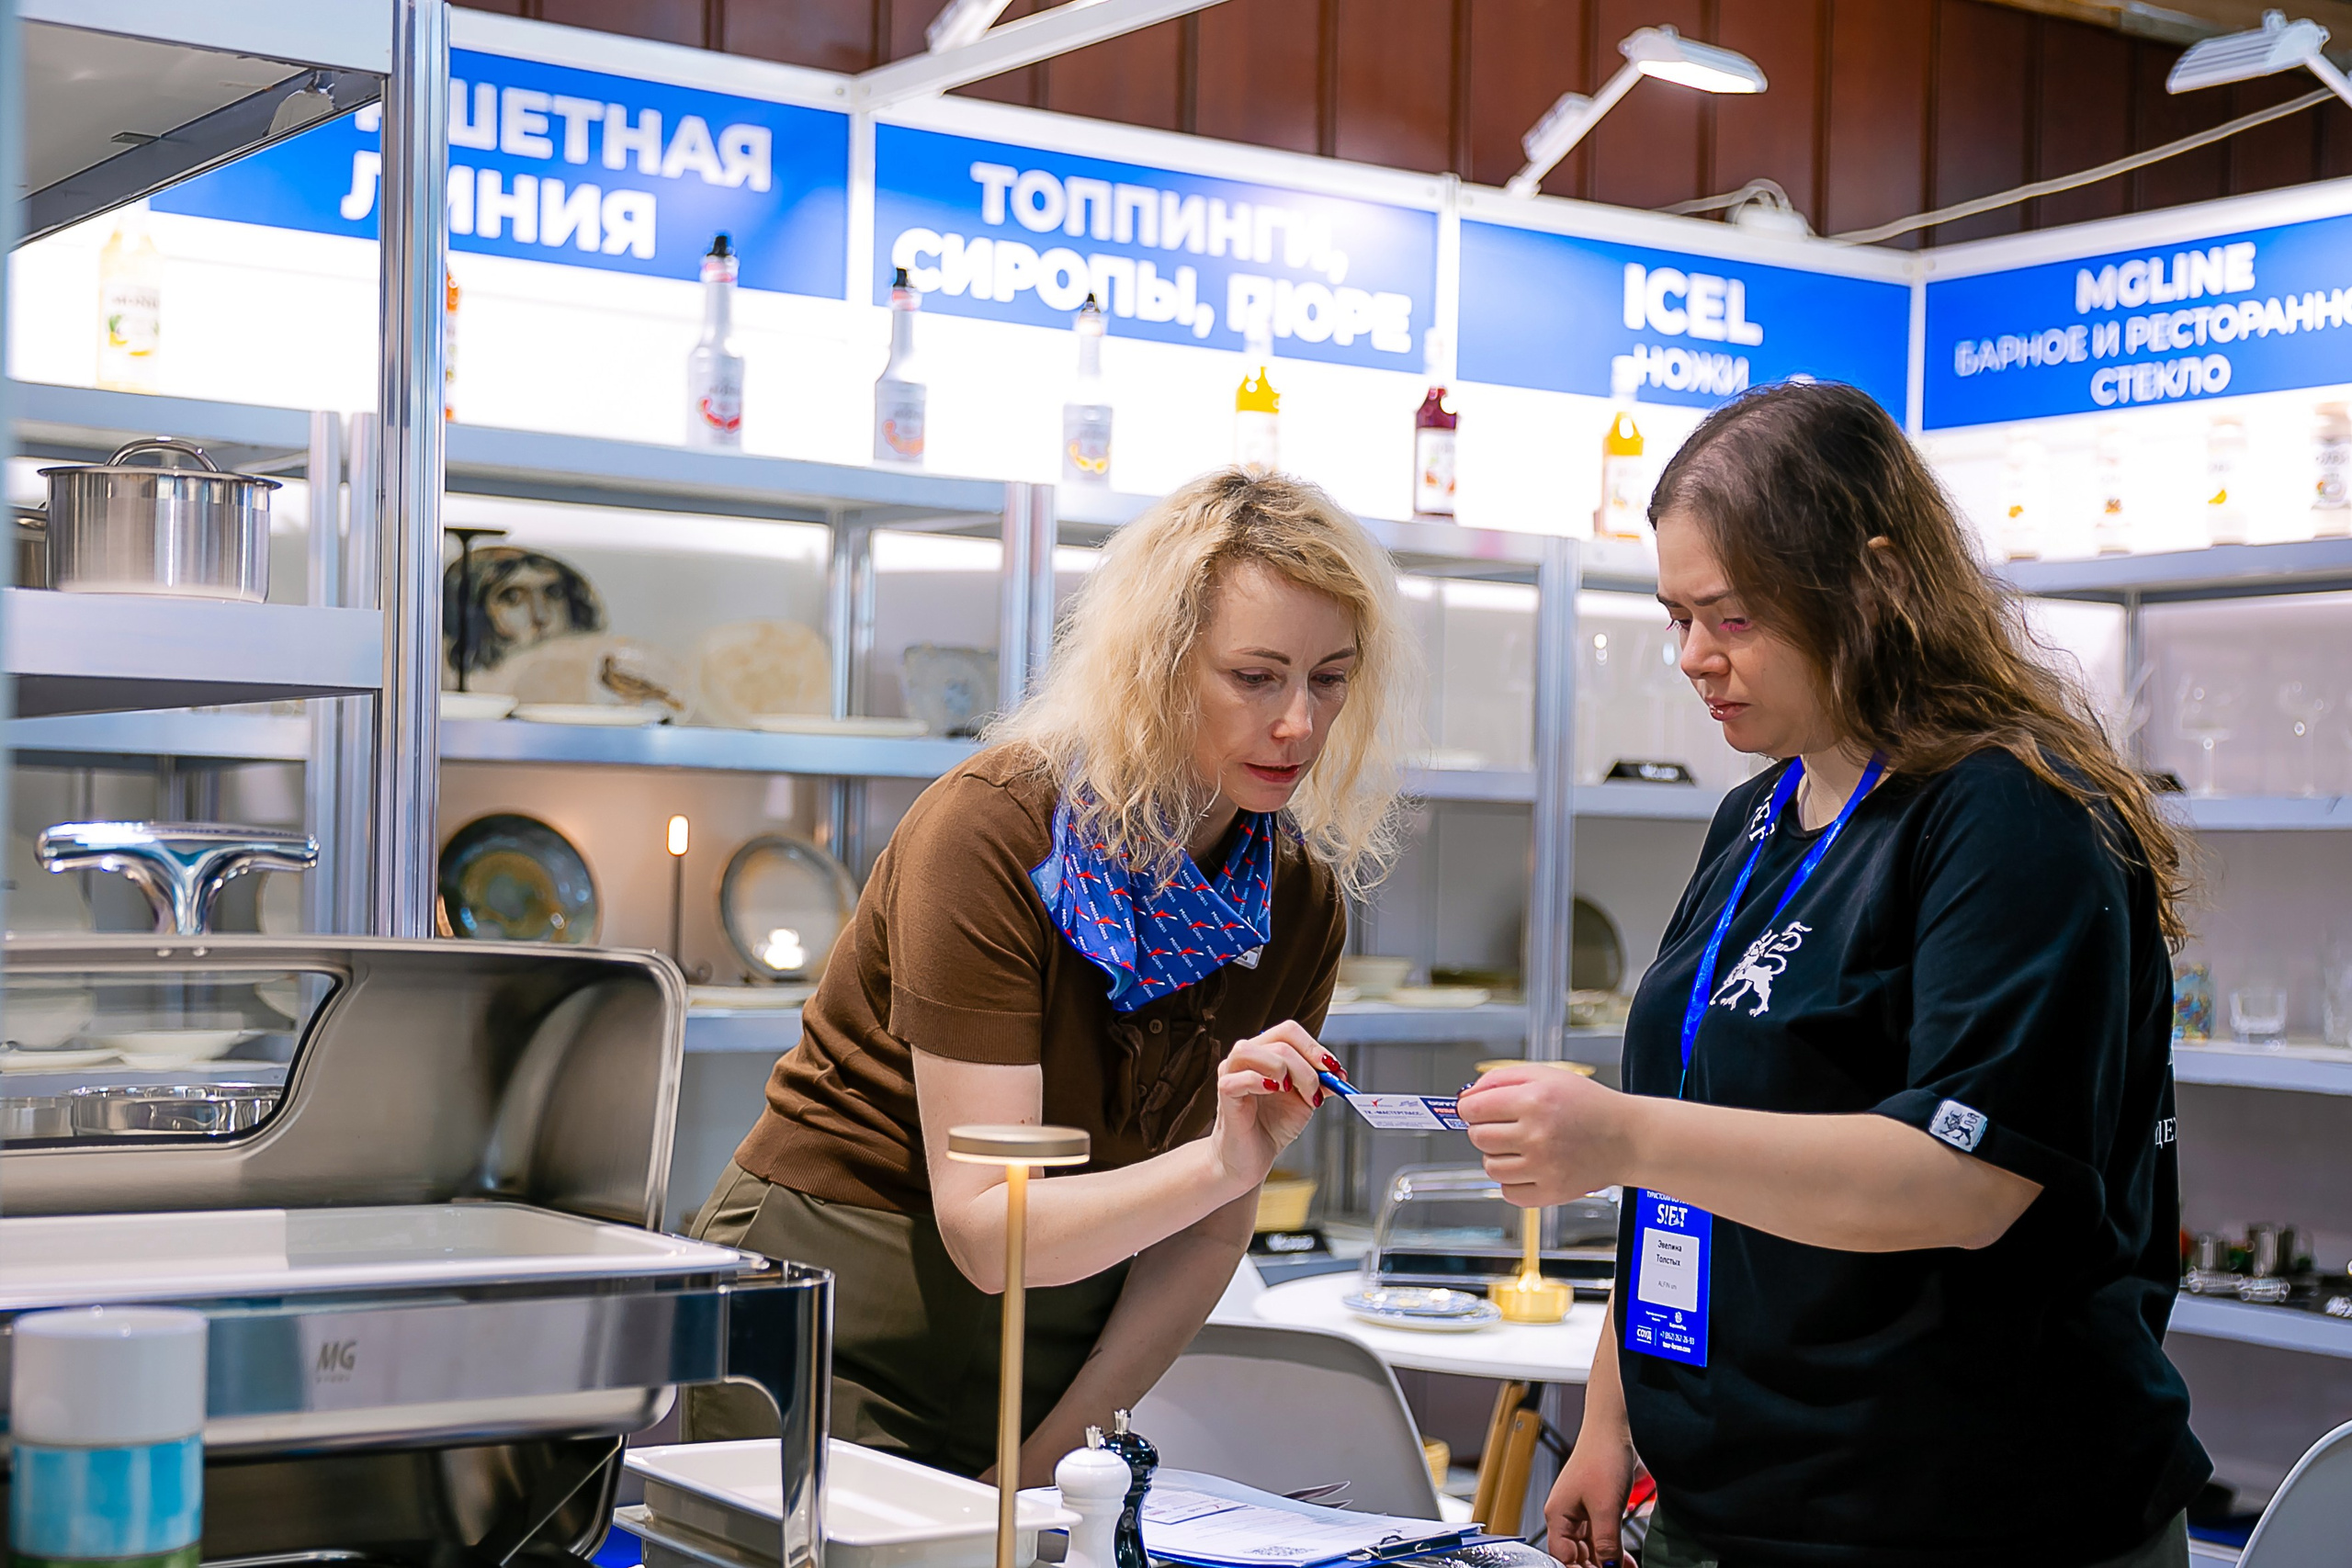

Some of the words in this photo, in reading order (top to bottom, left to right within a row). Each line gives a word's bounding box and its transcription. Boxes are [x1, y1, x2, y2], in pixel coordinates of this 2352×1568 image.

[970, 162, 1349, 285] ТОППИНГИ,
[892, 227, 1215, 339] СИРОПЫ,
[1623, 262, 1764, 347] ICEL
[2075, 241, 2256, 314] MGLINE
[1633, 343, 1750, 397] НОЖИ
[1954, 324, 2089, 378] БАРНОЕ
[2092, 321, 2120, 359] И
[2089, 353, 2233, 406] СТЕКЛО
[316, 1339, 357, 1371] MG
